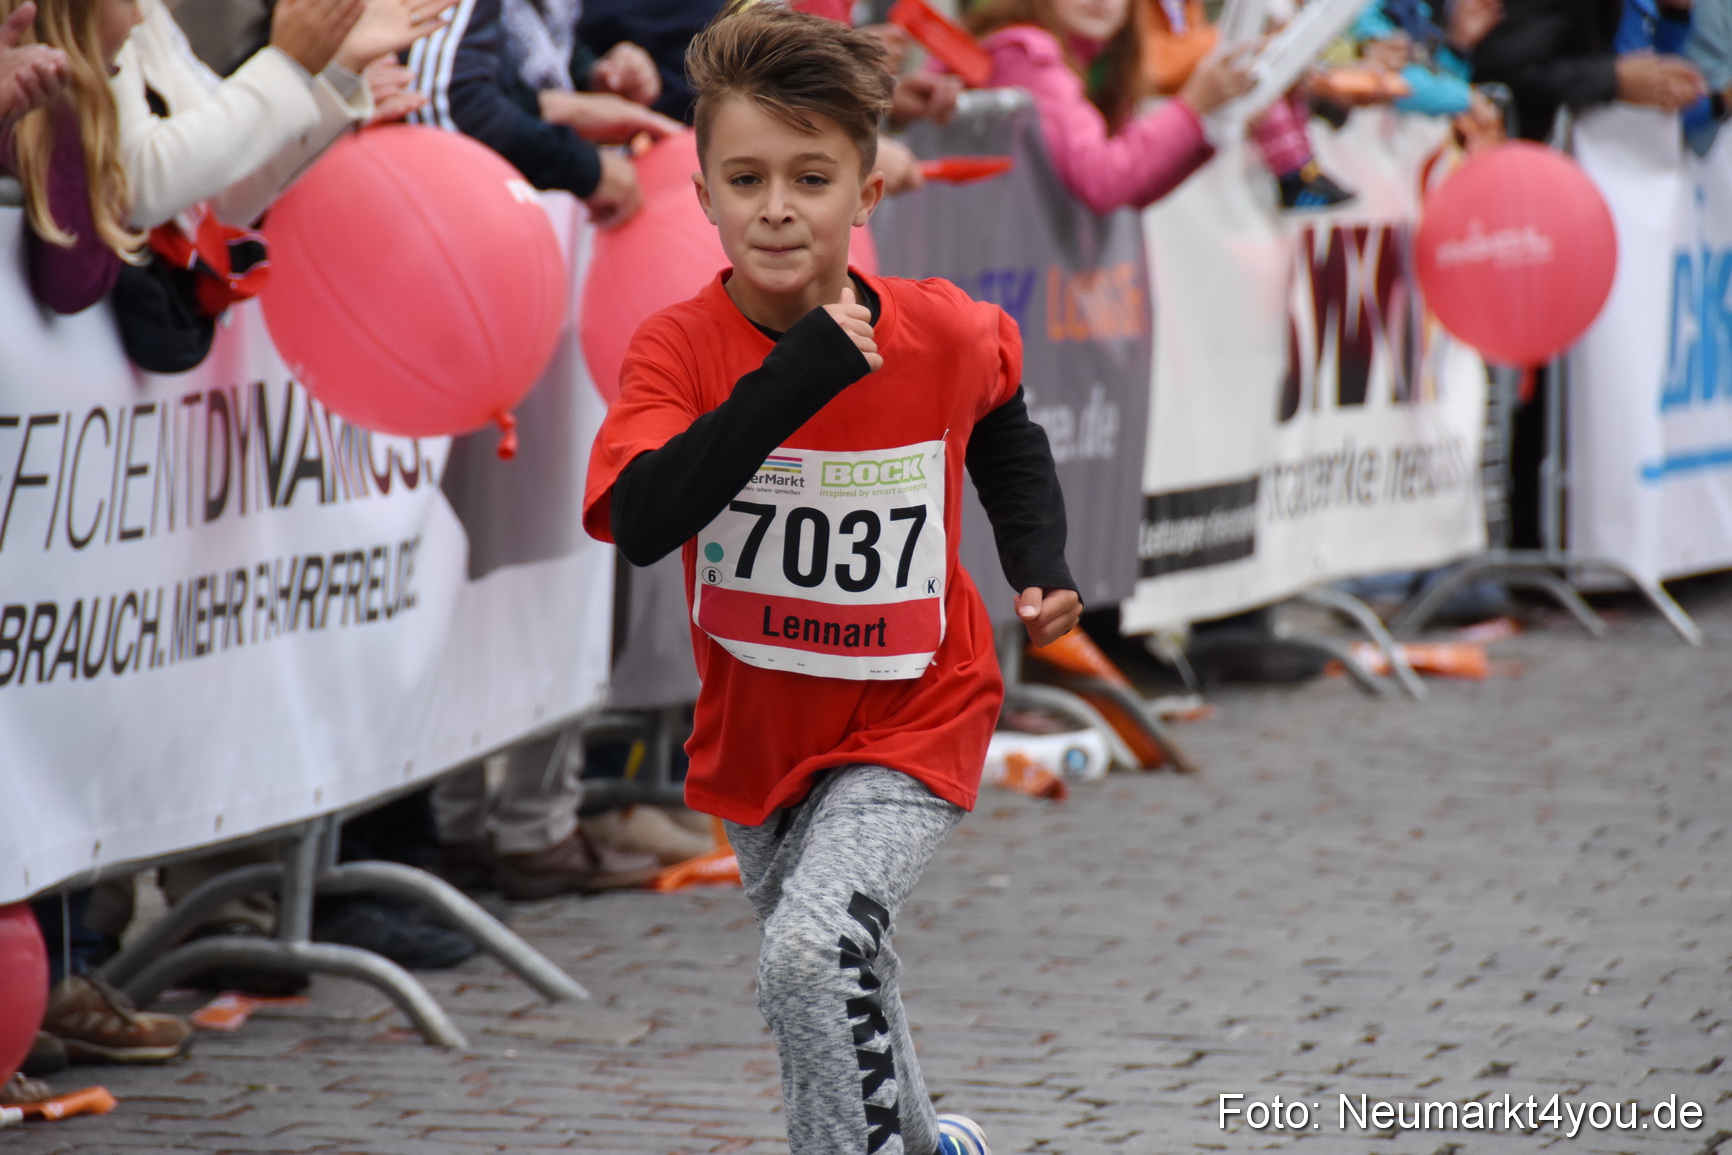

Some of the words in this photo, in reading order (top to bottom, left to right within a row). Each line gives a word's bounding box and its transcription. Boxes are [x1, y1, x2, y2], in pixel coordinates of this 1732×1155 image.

[750, 473, 805, 488] erMarkt
[821, 454, 926, 487] BOCK
[819, 488, 857, 499] inspired
[859, 489, 870, 498] by
[872, 487, 896, 496] smart
[897, 482, 927, 494] concepts
[729, 500, 928, 592] 7037
[708, 569, 717, 583] 6
[927, 579, 937, 594] K
[170, 568, 248, 664] MEHR
[762, 605, 887, 648] Lennart
